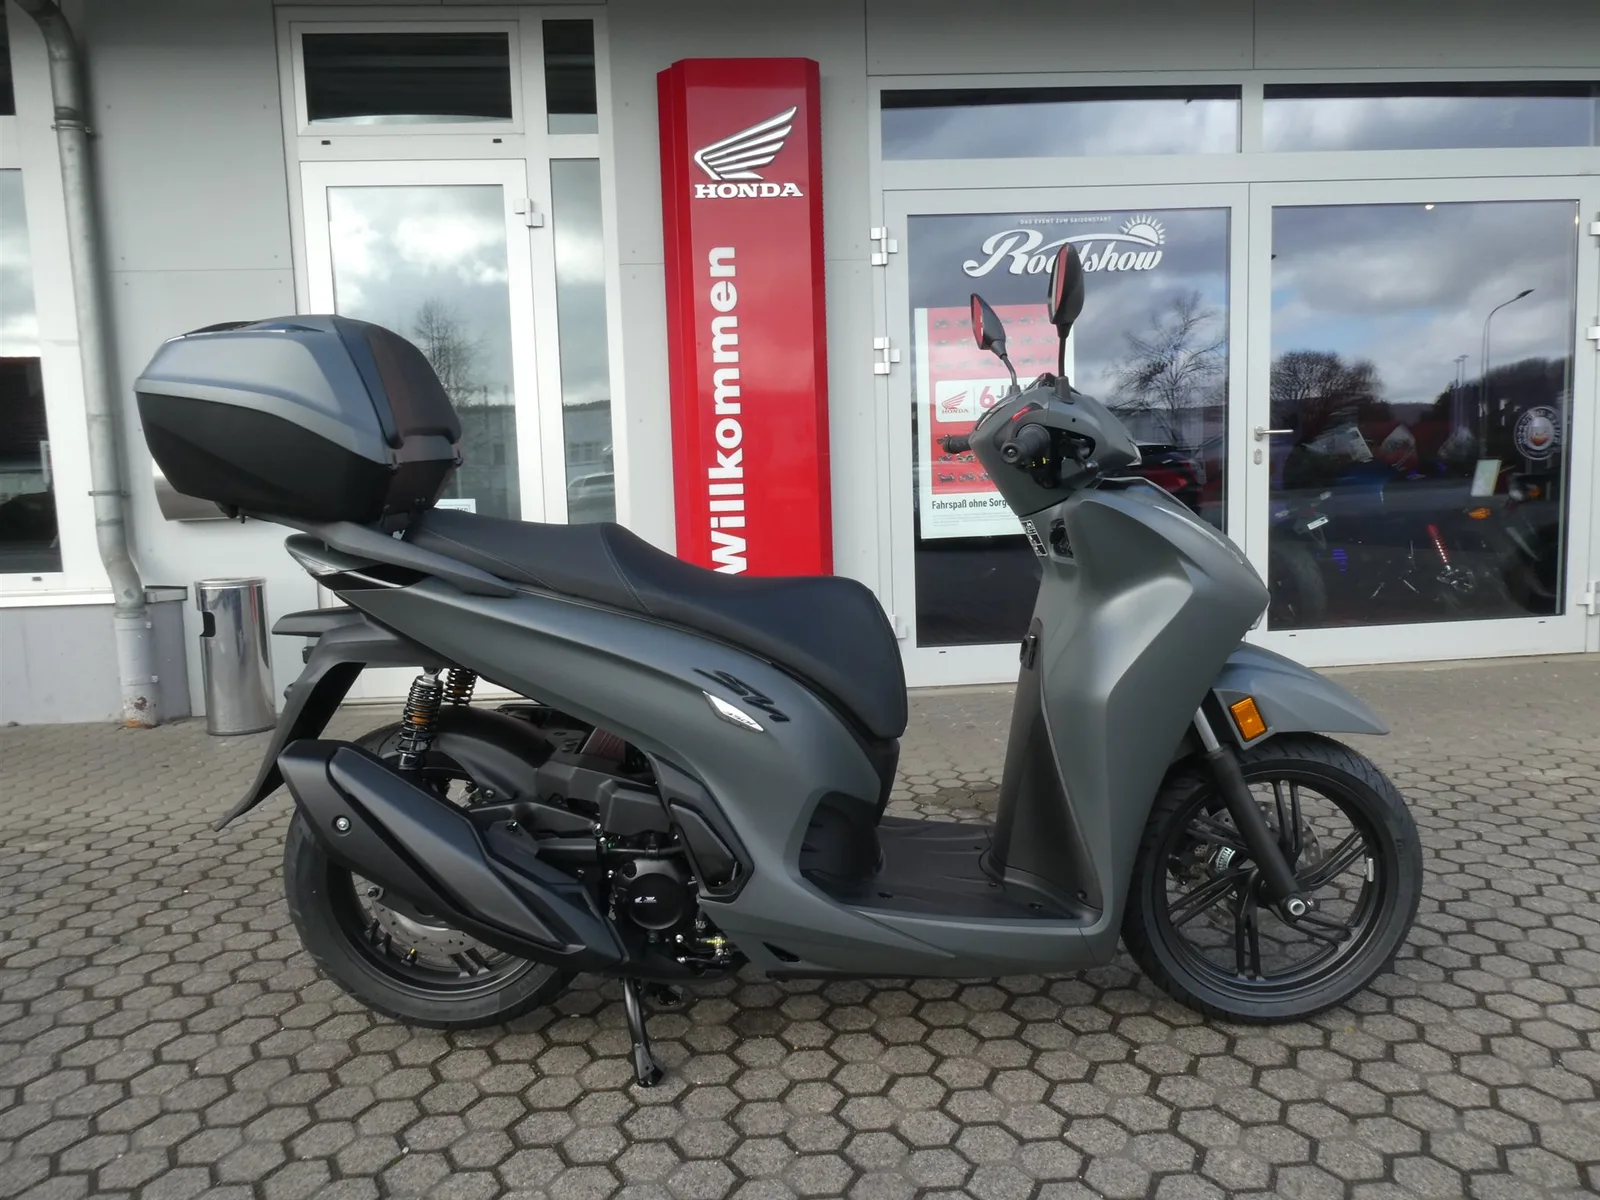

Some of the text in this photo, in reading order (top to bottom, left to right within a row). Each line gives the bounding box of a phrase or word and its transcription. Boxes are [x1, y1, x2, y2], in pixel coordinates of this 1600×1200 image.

[694, 183, 804, 199] HONDA
[708, 246, 748, 575] Willkommen
[932, 498, 1007, 511] Fahrspaß ohne Sorg
